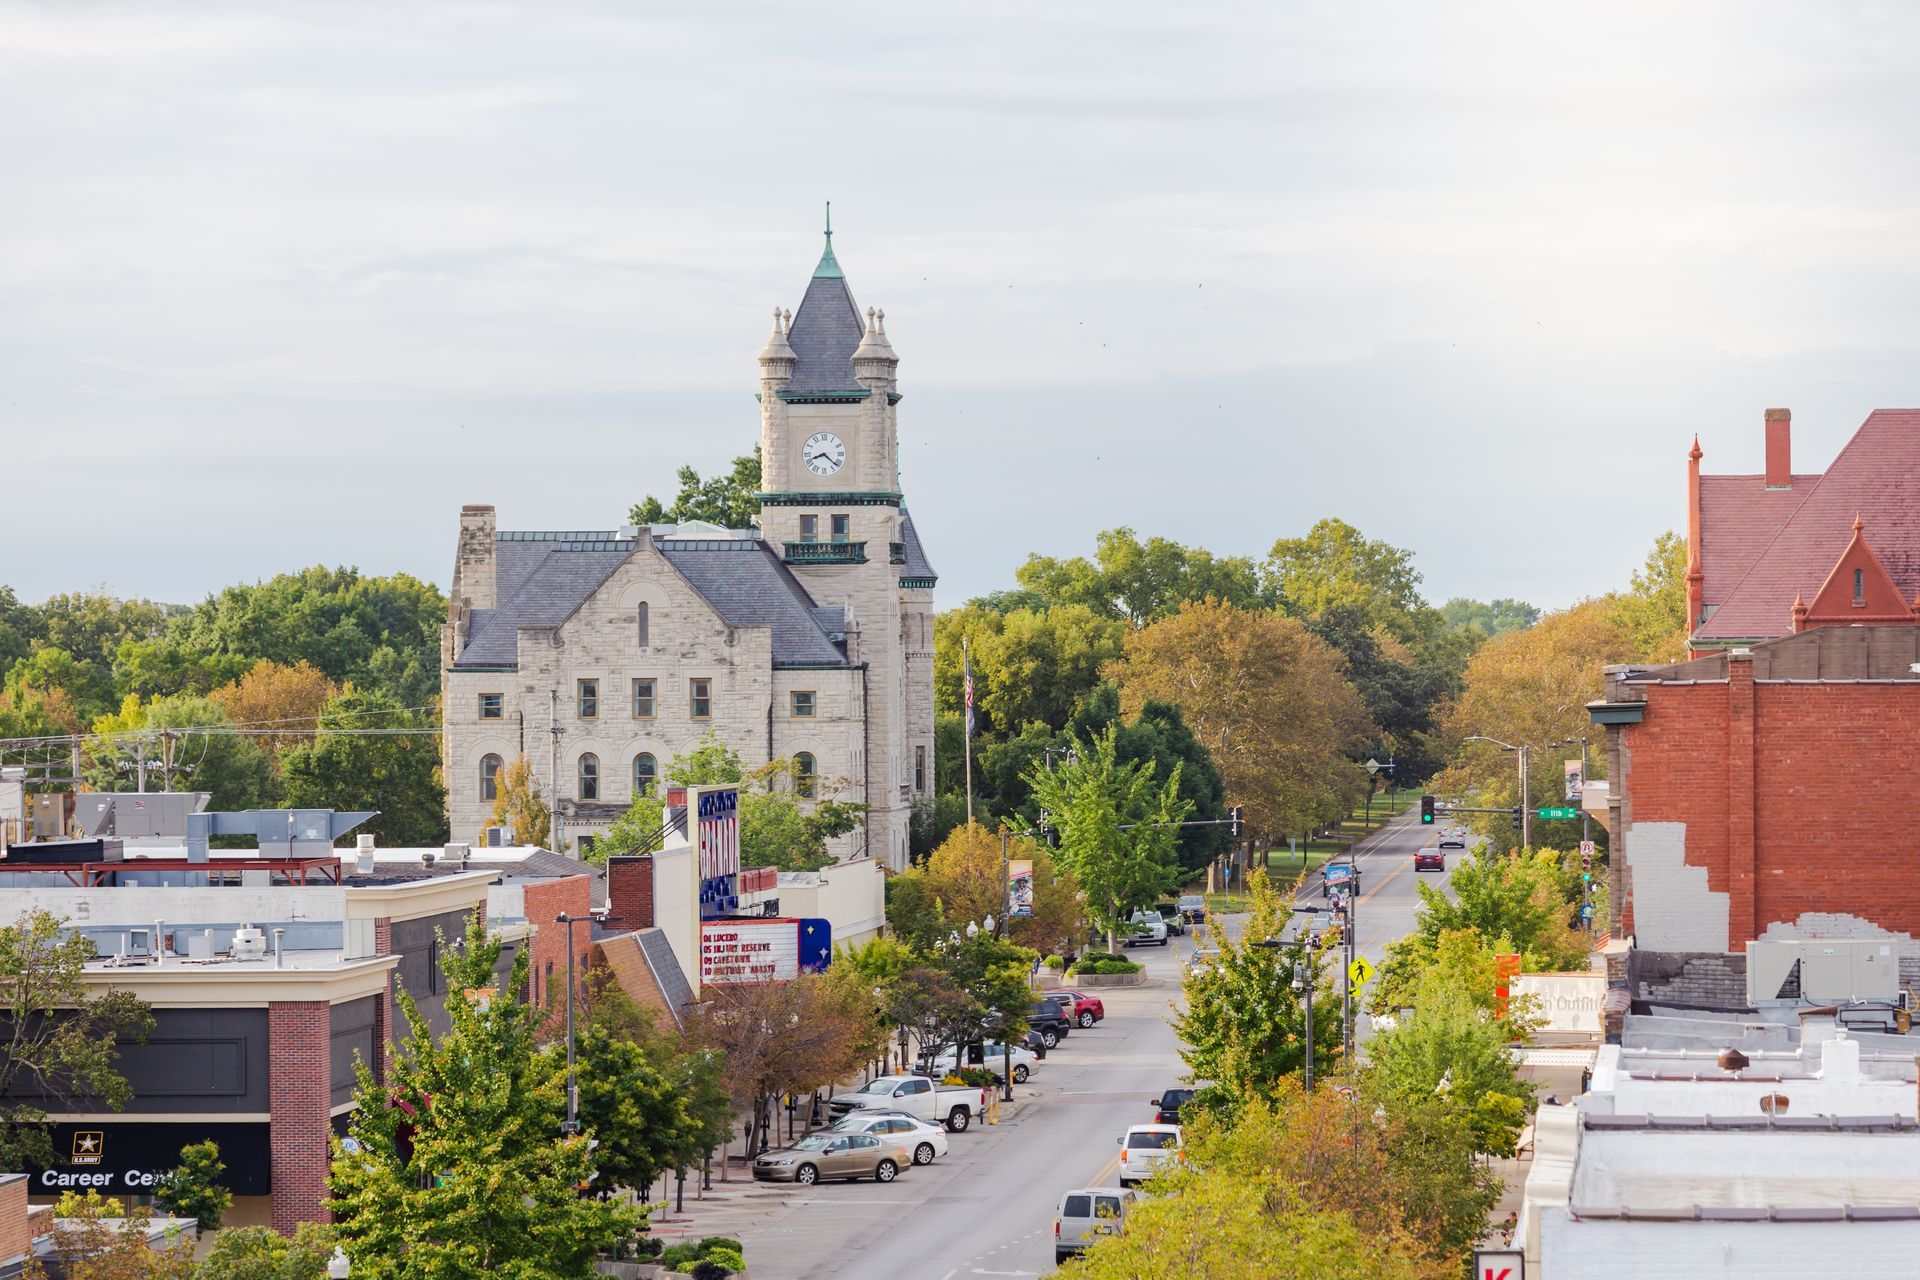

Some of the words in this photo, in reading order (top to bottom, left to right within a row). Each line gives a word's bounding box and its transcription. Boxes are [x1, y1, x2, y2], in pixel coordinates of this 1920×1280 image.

[700, 817, 740, 880] GRANADA
[713, 933, 738, 942] LUCERO
[703, 945, 712, 953] 05
[741, 943, 771, 952] RESERVE
[703, 956, 712, 965] 09
[704, 967, 712, 975] 10
[41, 1170, 114, 1186] Career
